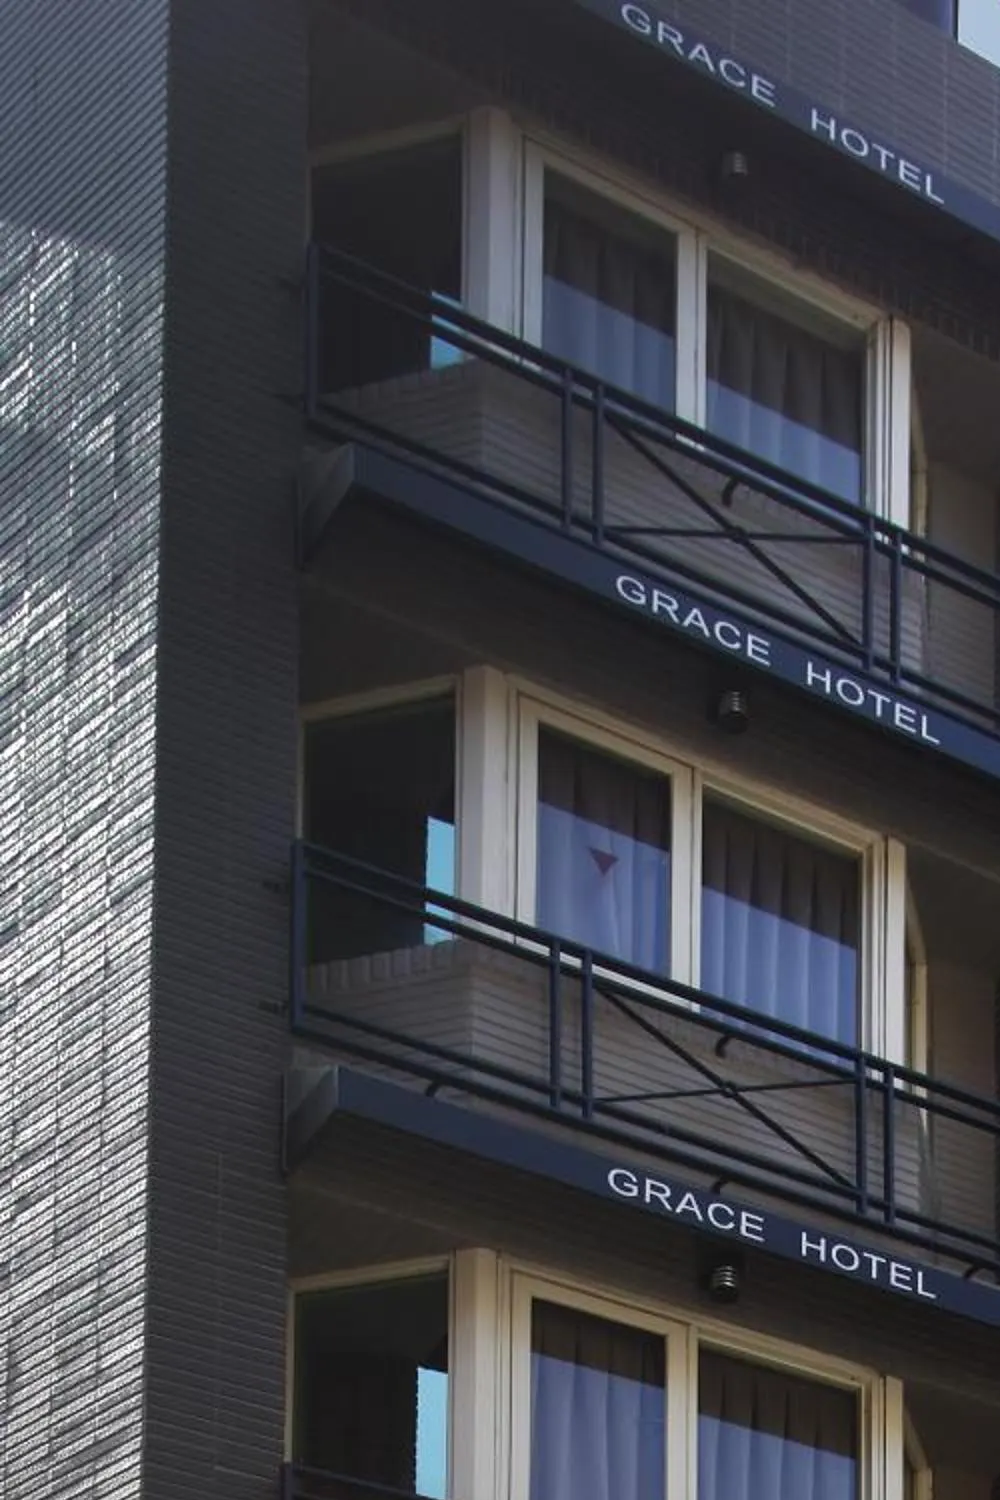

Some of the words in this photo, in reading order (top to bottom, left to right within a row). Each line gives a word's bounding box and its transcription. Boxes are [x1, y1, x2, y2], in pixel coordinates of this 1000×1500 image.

[621, 3, 775, 108] GRACE
[810, 108, 945, 205] HOTEL
[616, 574, 771, 666] GRACE
[805, 660, 940, 746] HOTEL
[607, 1167, 766, 1242] GRACE
[801, 1231, 938, 1300] HOTEL
